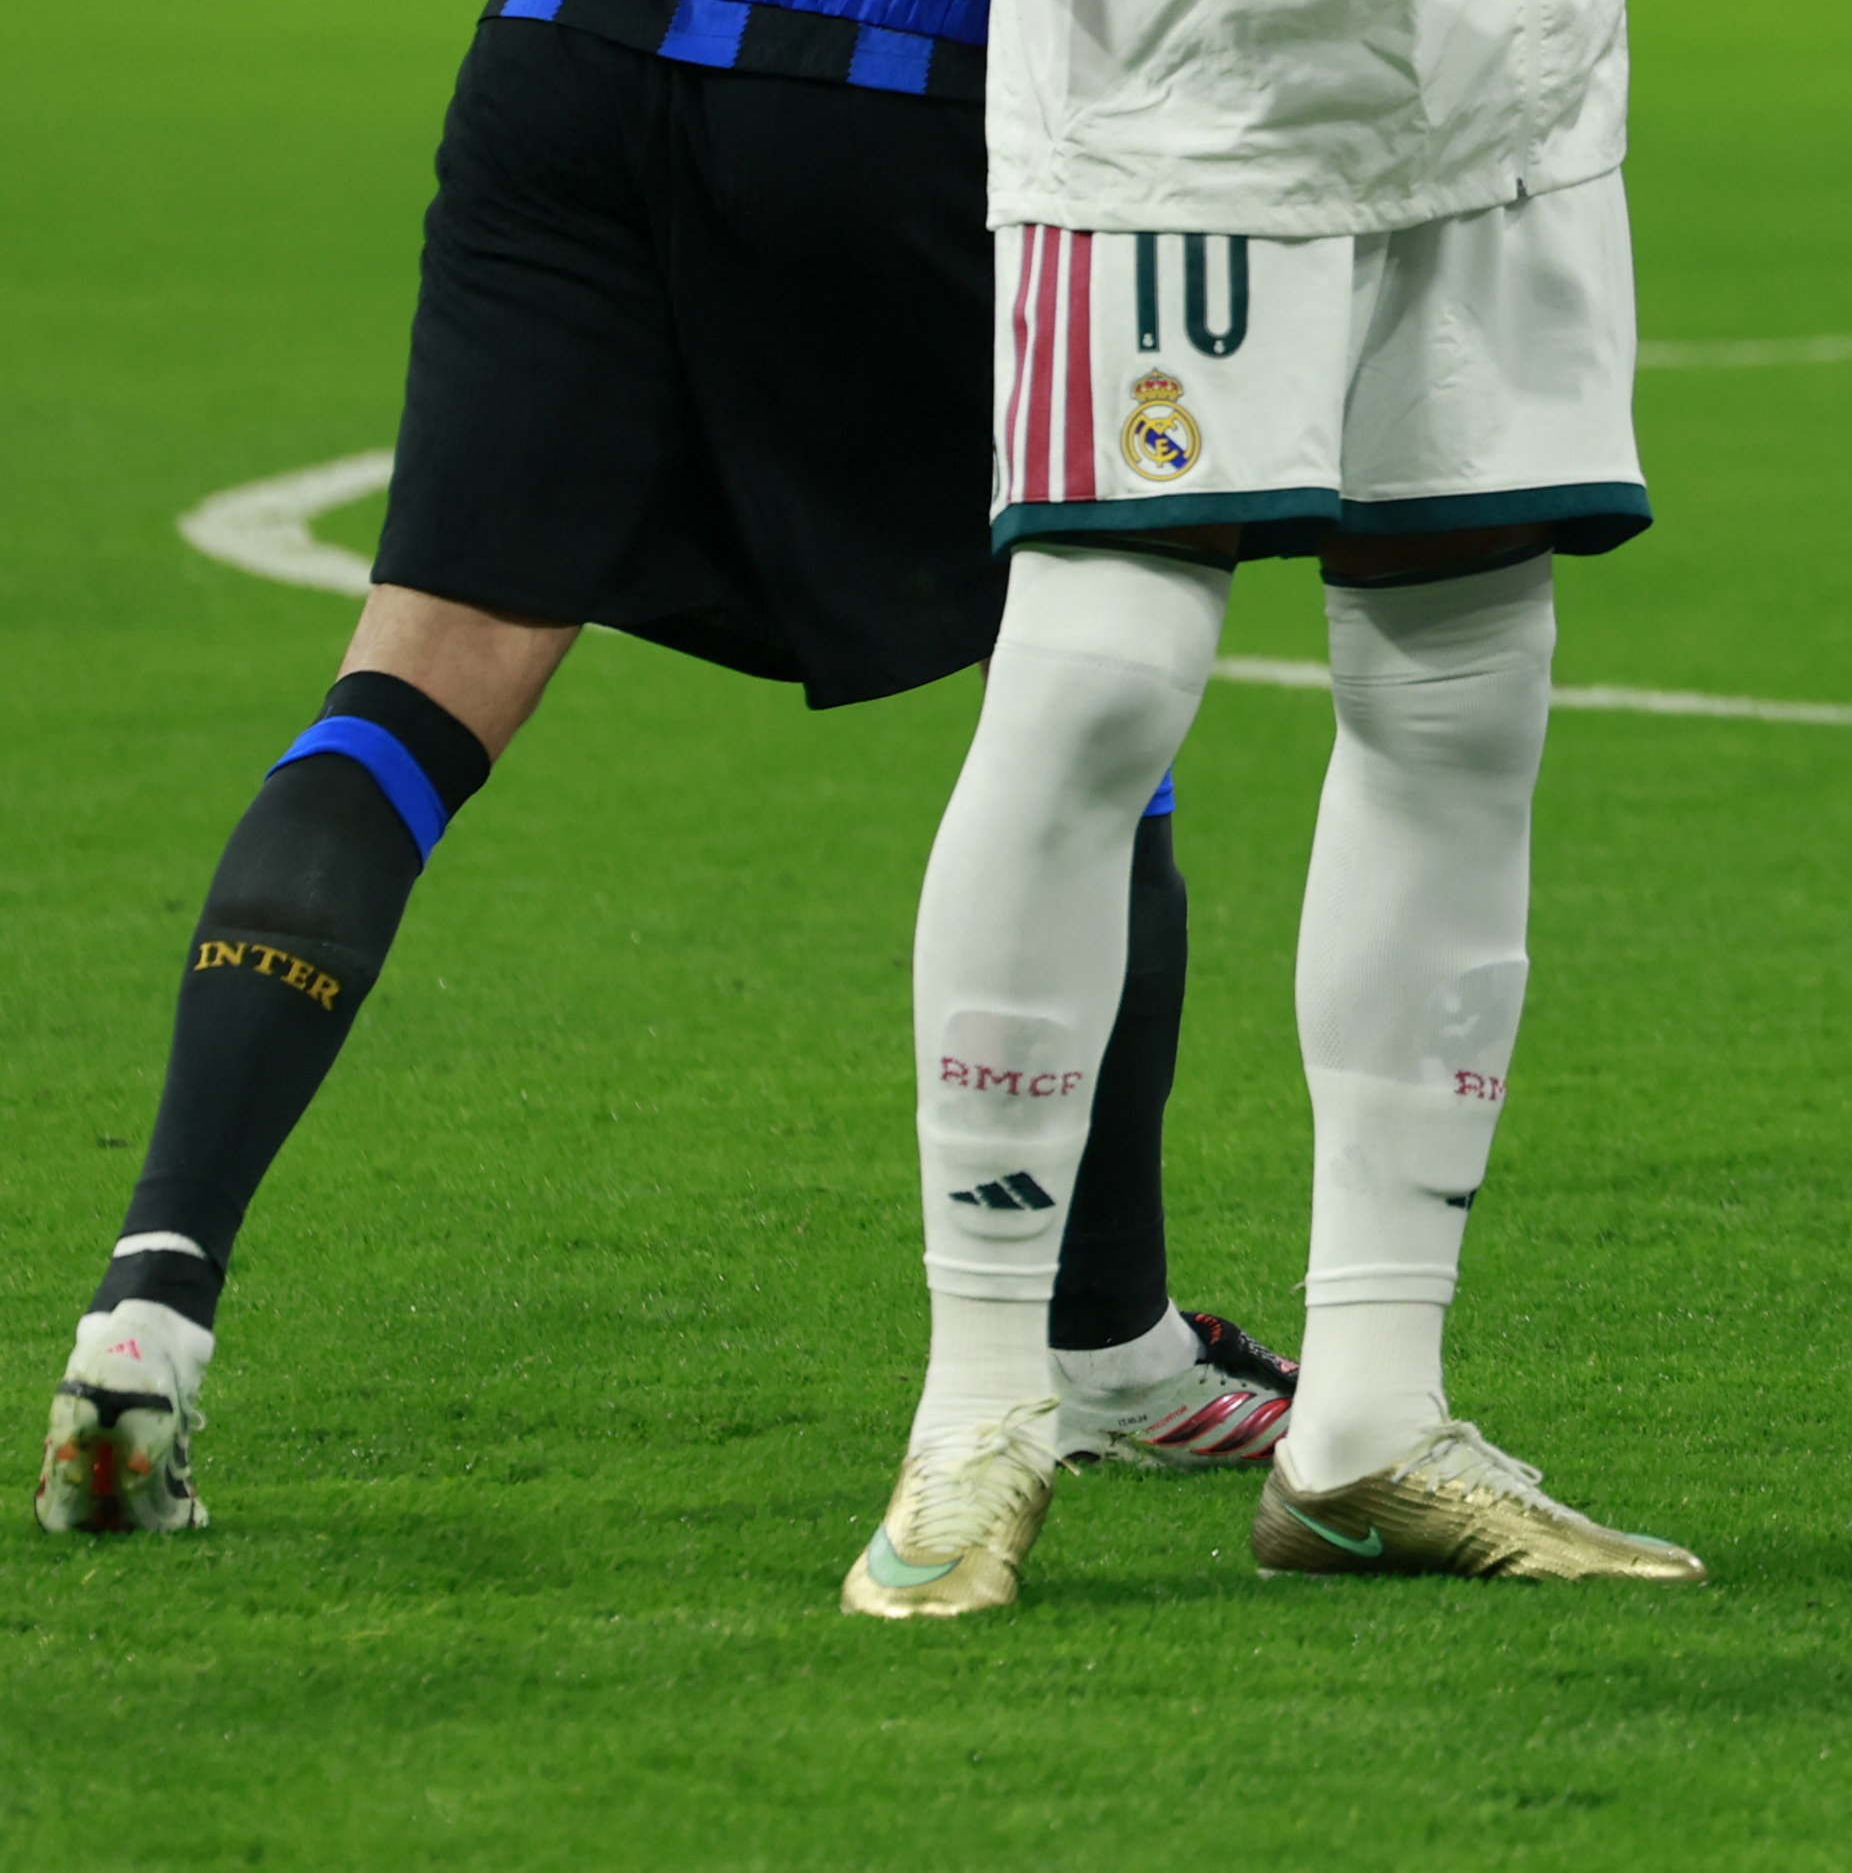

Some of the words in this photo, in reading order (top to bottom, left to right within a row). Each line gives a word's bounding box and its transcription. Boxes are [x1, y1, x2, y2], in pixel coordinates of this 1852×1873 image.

[1135, 231, 1249, 359] 10
[194, 941, 341, 1011] INTER
[941, 1056, 1083, 1097] RMCF
